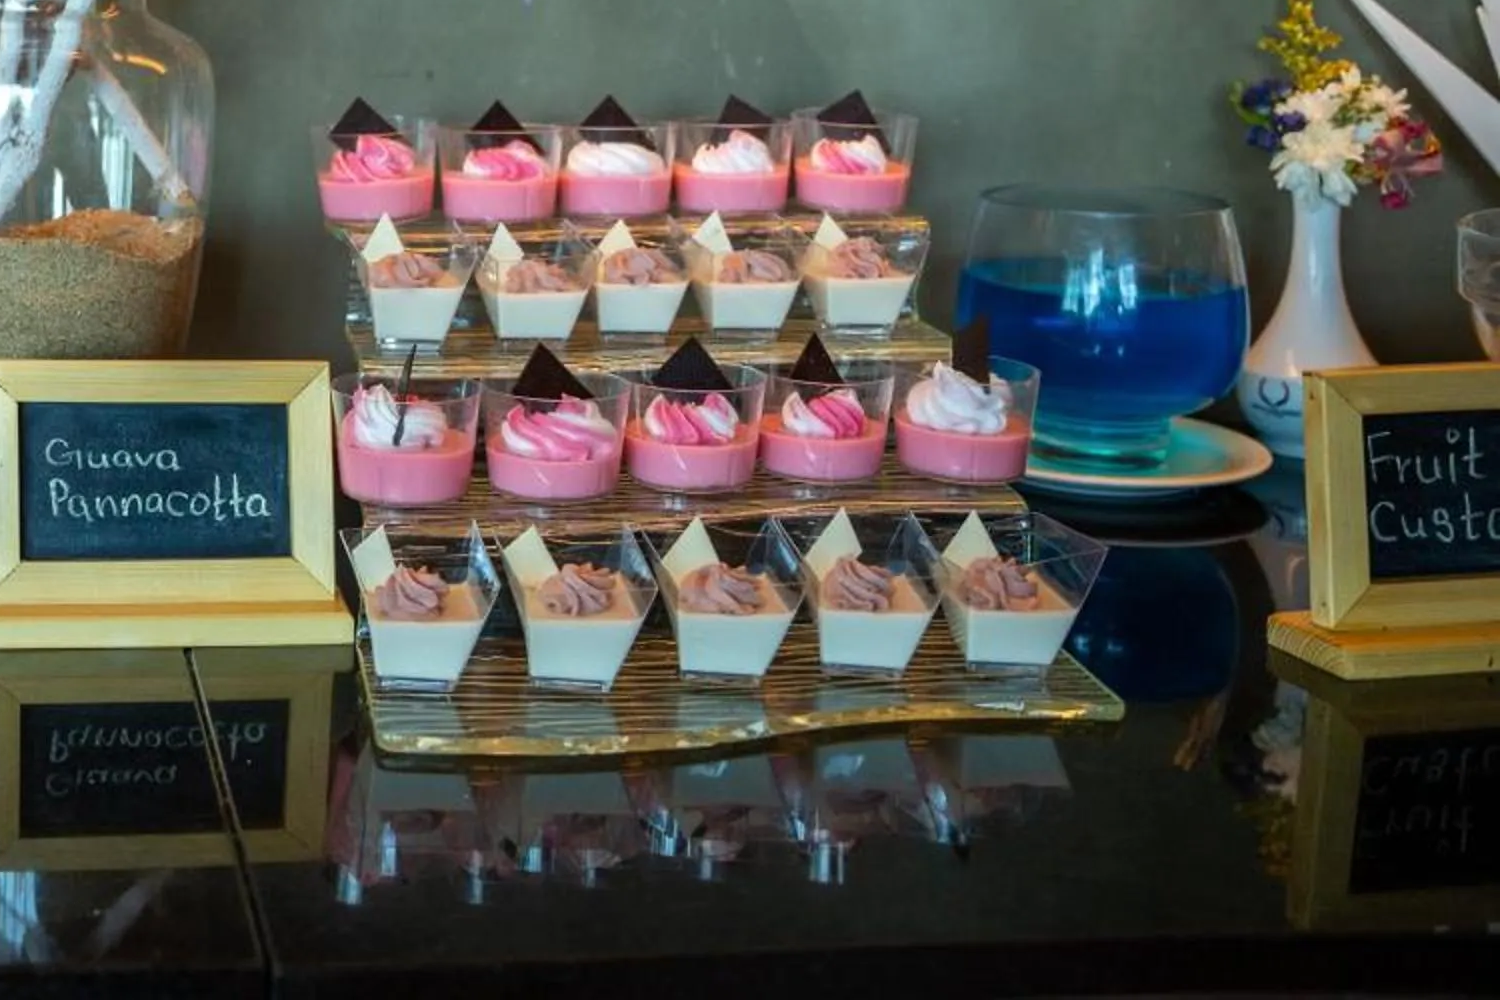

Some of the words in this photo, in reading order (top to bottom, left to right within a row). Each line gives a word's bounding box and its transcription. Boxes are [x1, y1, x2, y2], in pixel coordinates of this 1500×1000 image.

[45, 438, 180, 473] Guava
[1367, 427, 1486, 484] Fruit
[49, 473, 272, 524] Pannacotta
